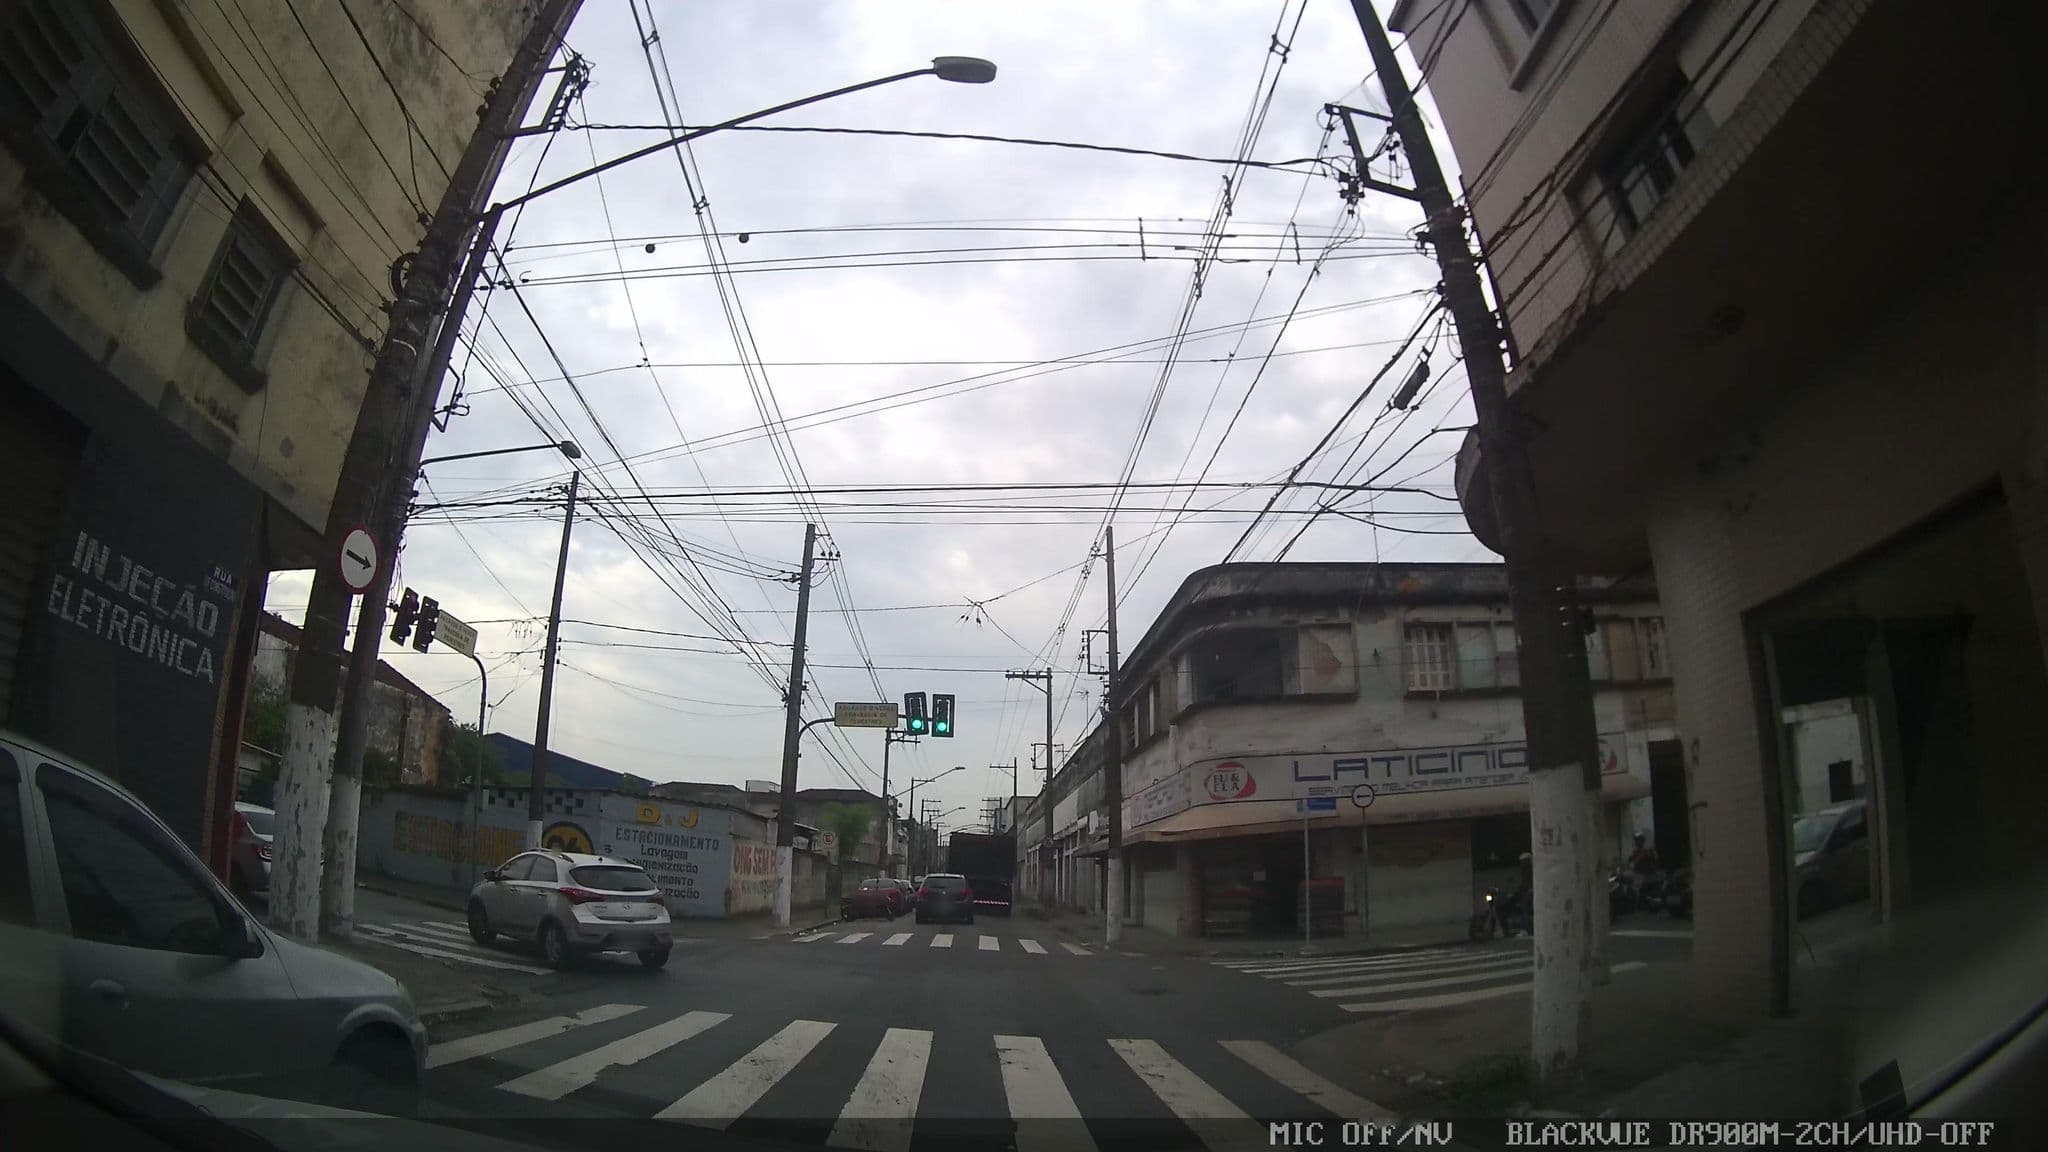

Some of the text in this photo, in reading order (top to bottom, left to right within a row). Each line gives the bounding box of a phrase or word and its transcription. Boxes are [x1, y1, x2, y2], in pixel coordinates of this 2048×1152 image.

[72, 530, 219, 638] INJEÇÃO
[213, 566, 232, 585] RUA
[48, 574, 214, 684] ELETRÔNICA
[635, 804, 661, 825] D
[678, 806, 699, 829] J
[615, 826, 720, 851] ESTACIONAMENTO
